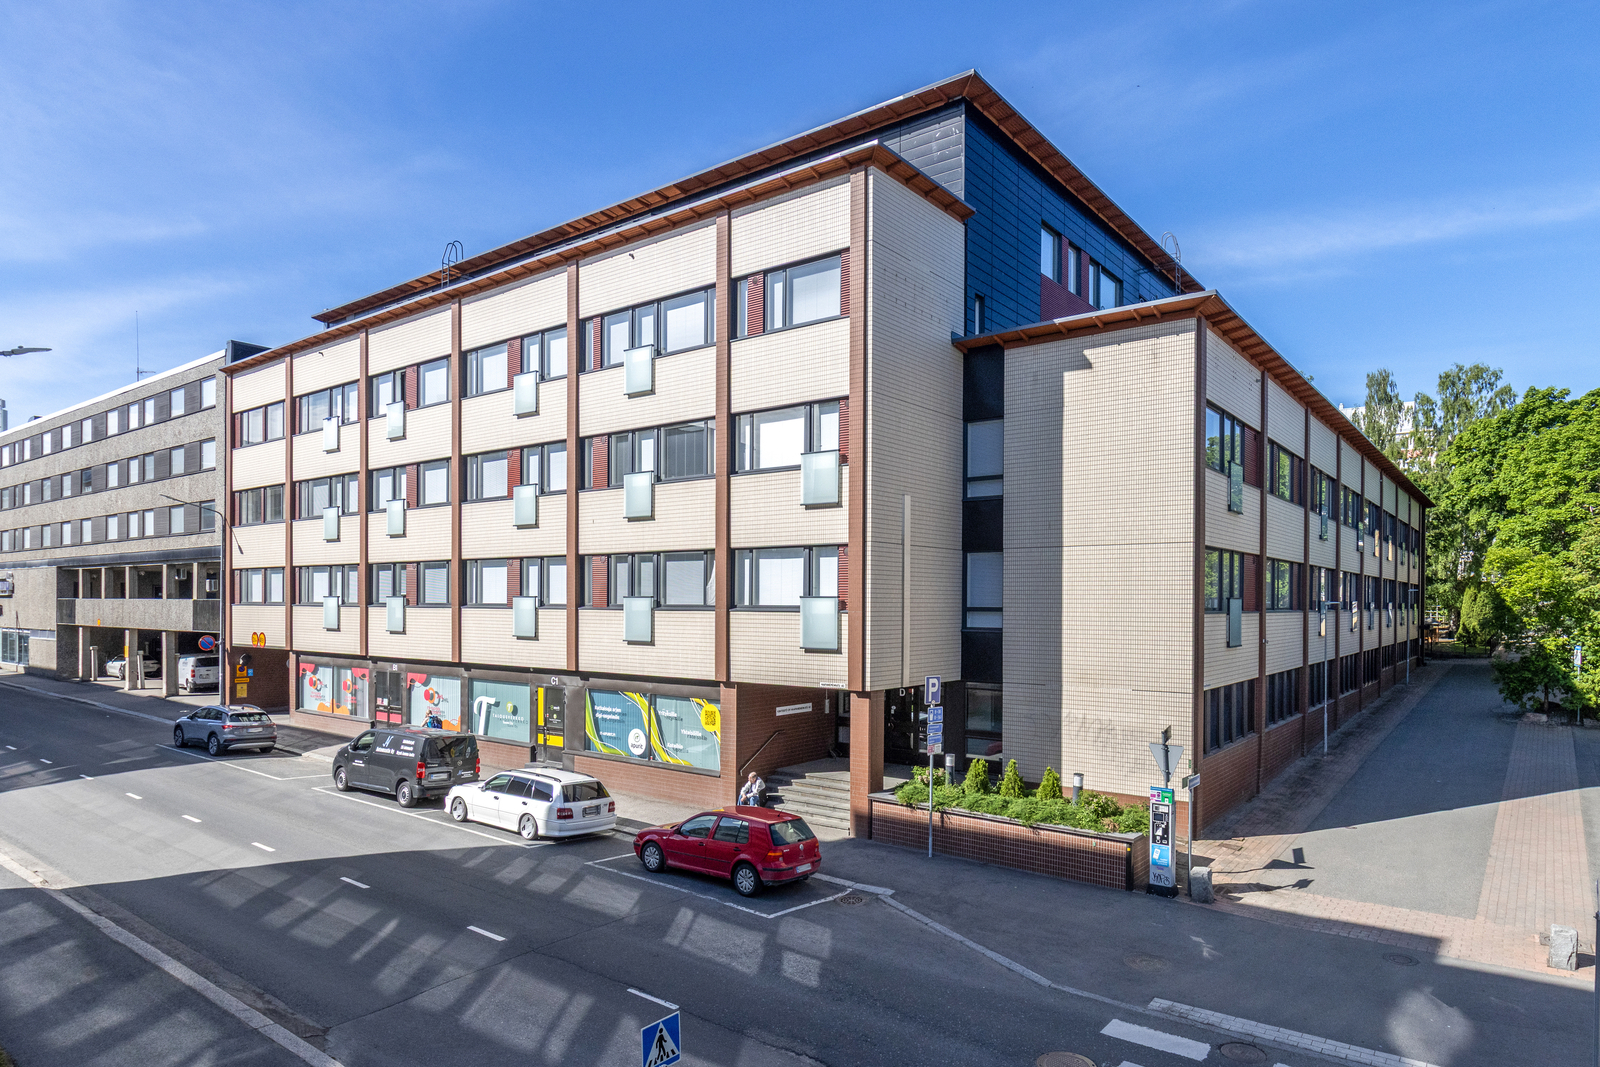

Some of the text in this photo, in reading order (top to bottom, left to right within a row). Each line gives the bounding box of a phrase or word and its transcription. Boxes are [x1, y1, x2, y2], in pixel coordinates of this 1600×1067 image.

[550, 676, 559, 685] C1
[900, 688, 906, 696] D
[928, 678, 939, 702] P
